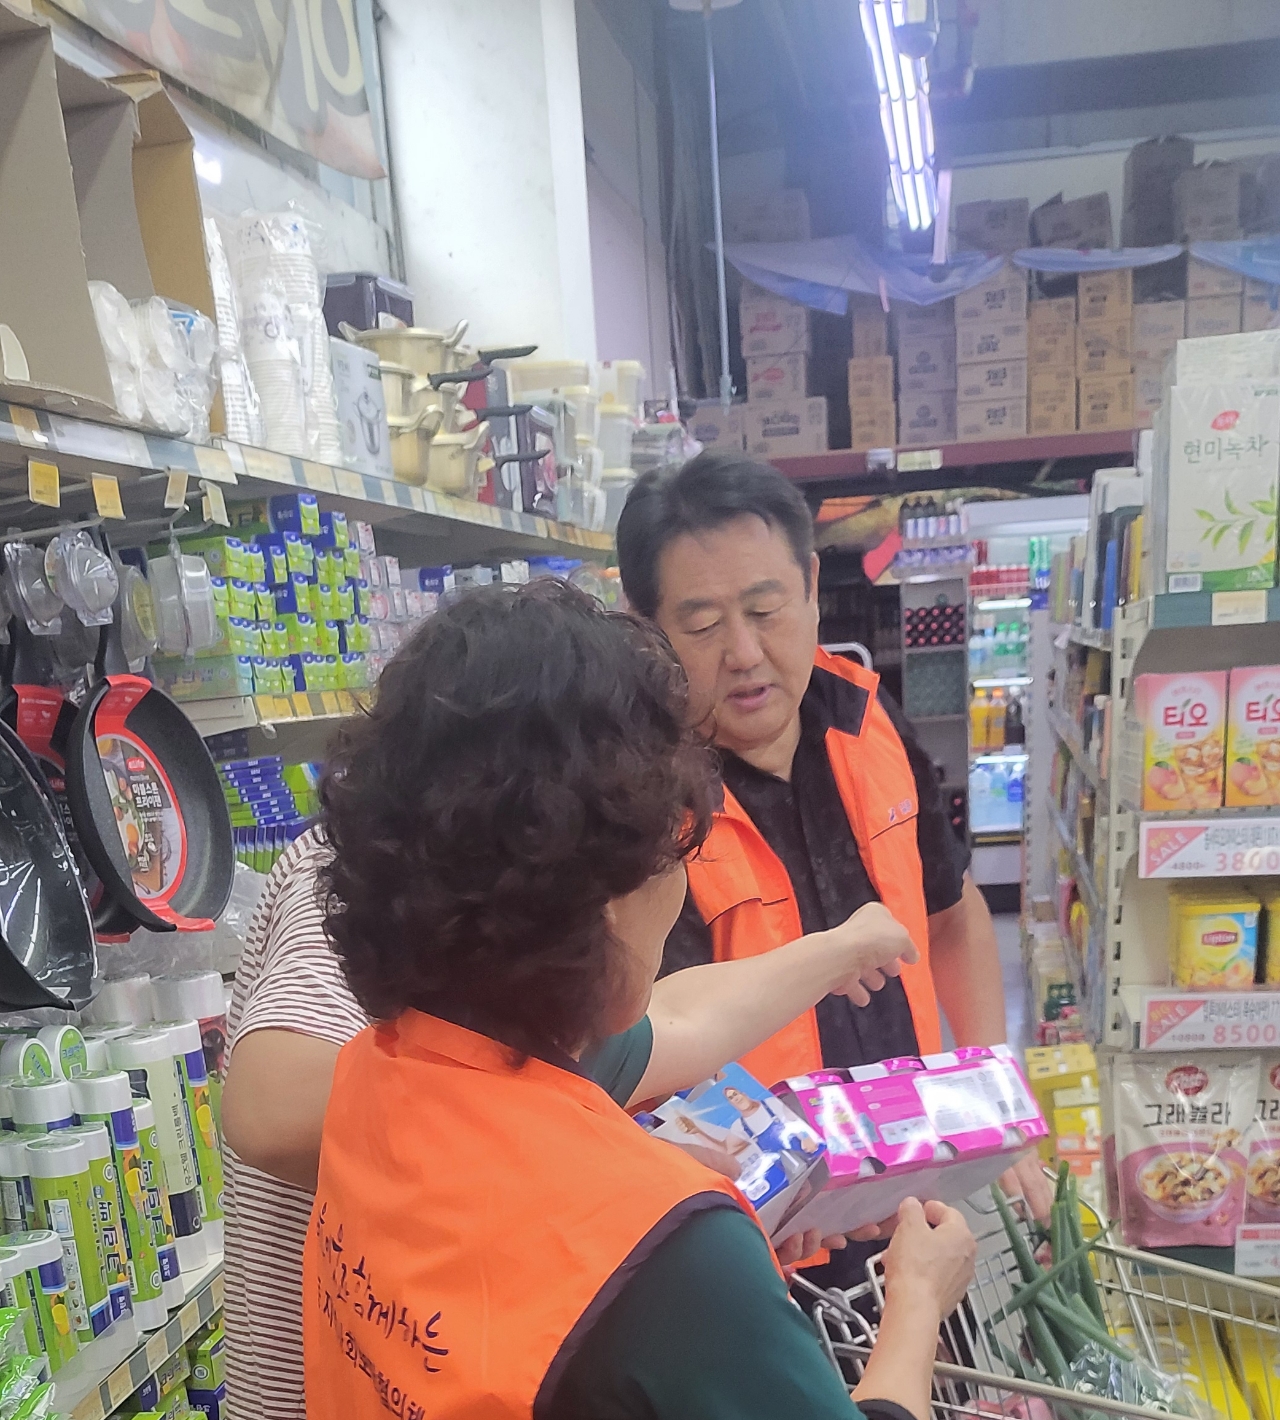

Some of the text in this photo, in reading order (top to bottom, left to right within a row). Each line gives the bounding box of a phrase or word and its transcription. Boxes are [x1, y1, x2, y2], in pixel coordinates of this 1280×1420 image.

[1183, 434, 1270, 465] 현미녹차
[1163, 702, 1208, 727] 티오
[132, 781, 159, 795] 마블스톤
[1150, 831, 1188, 865] SALE
[1215, 851, 1280, 872] 3800
[1150, 1004, 1188, 1035] SALE
[1212, 1023, 1277, 1045] 8500
[98, 1200, 121, 1274] 크린백
